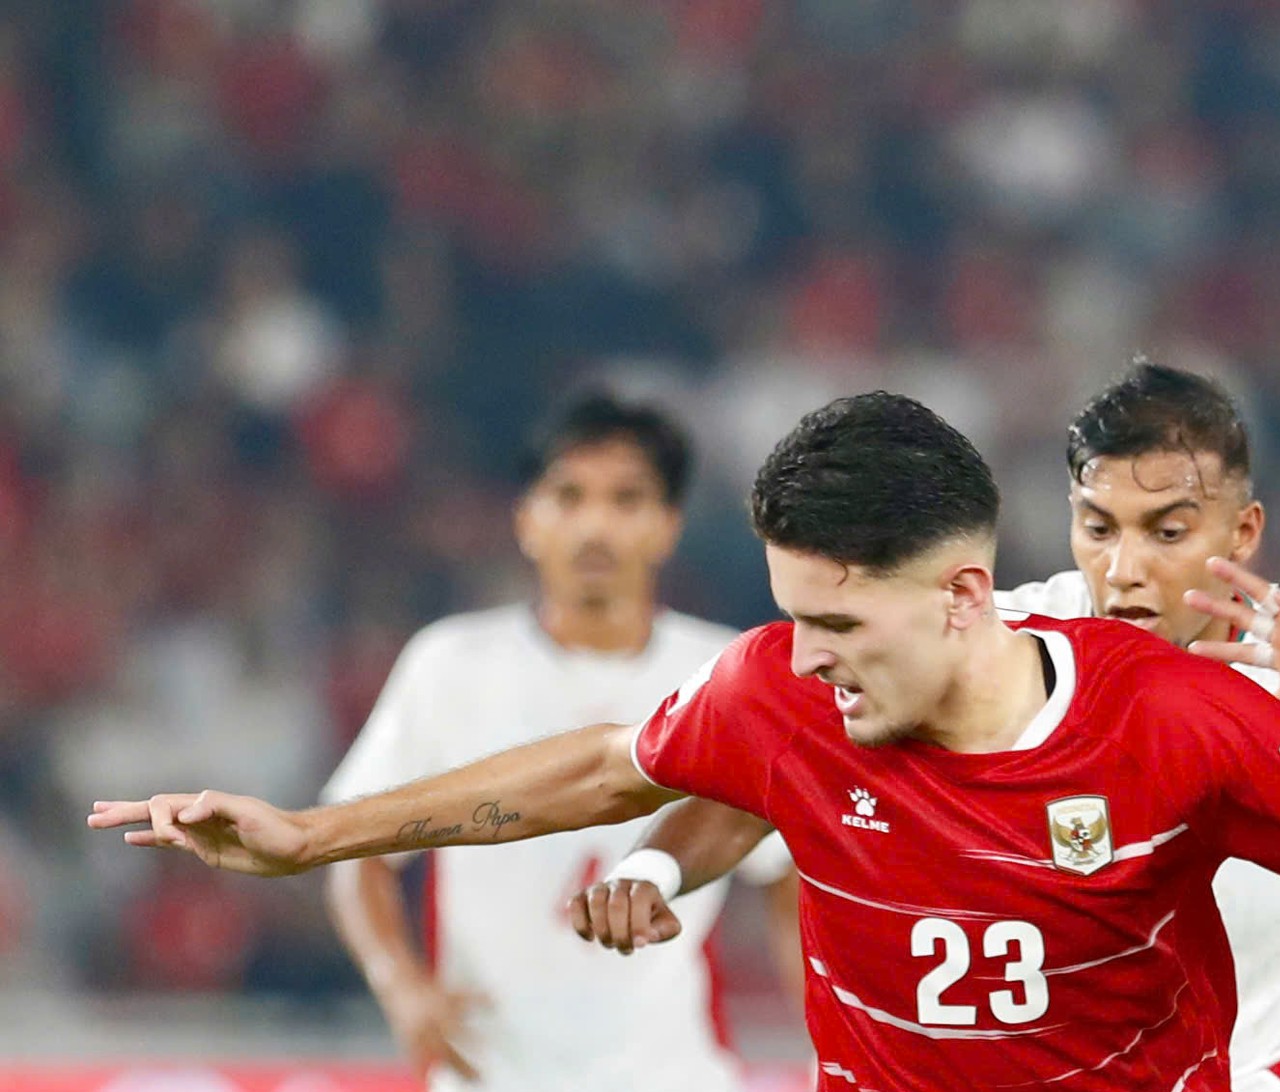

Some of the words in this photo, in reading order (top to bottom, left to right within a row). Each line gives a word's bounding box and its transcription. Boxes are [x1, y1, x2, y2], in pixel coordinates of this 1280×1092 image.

[472, 800, 521, 838] Papa
[841, 814, 890, 834] KELME
[910, 917, 1050, 1025] 23
